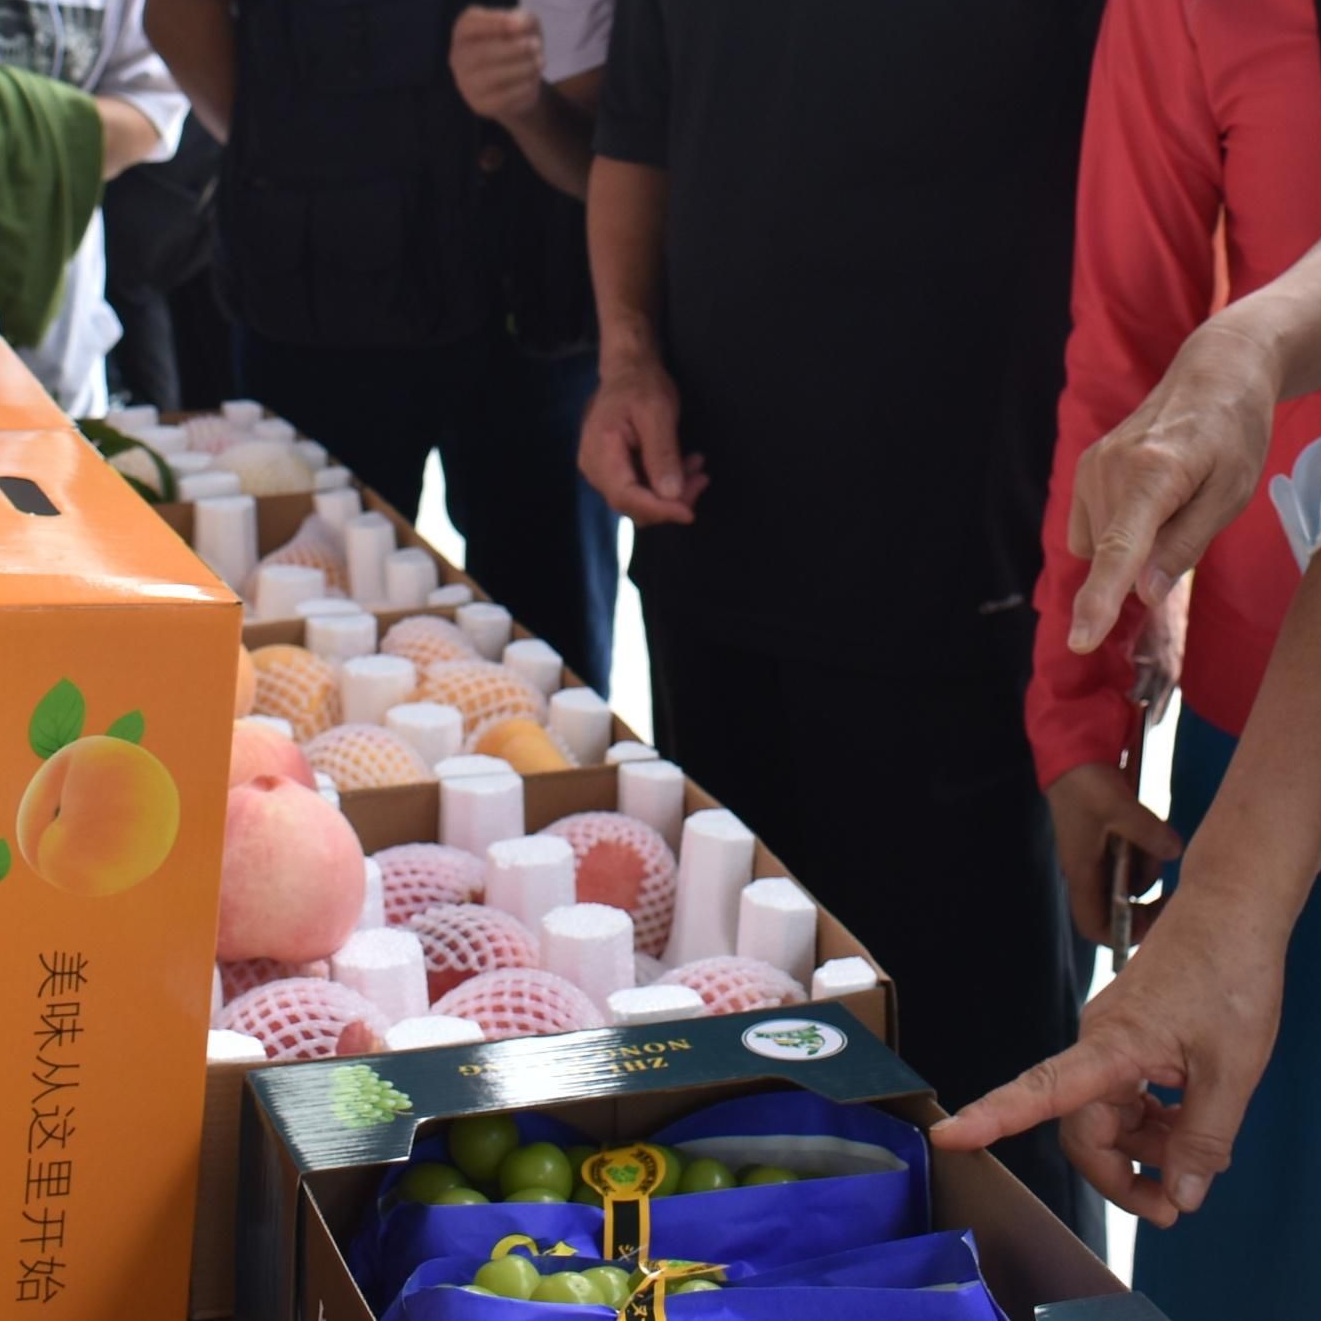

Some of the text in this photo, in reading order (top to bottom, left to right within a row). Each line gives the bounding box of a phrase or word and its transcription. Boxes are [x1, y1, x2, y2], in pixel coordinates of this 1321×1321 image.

[16, 950, 89, 1303] 美味从这里开始
